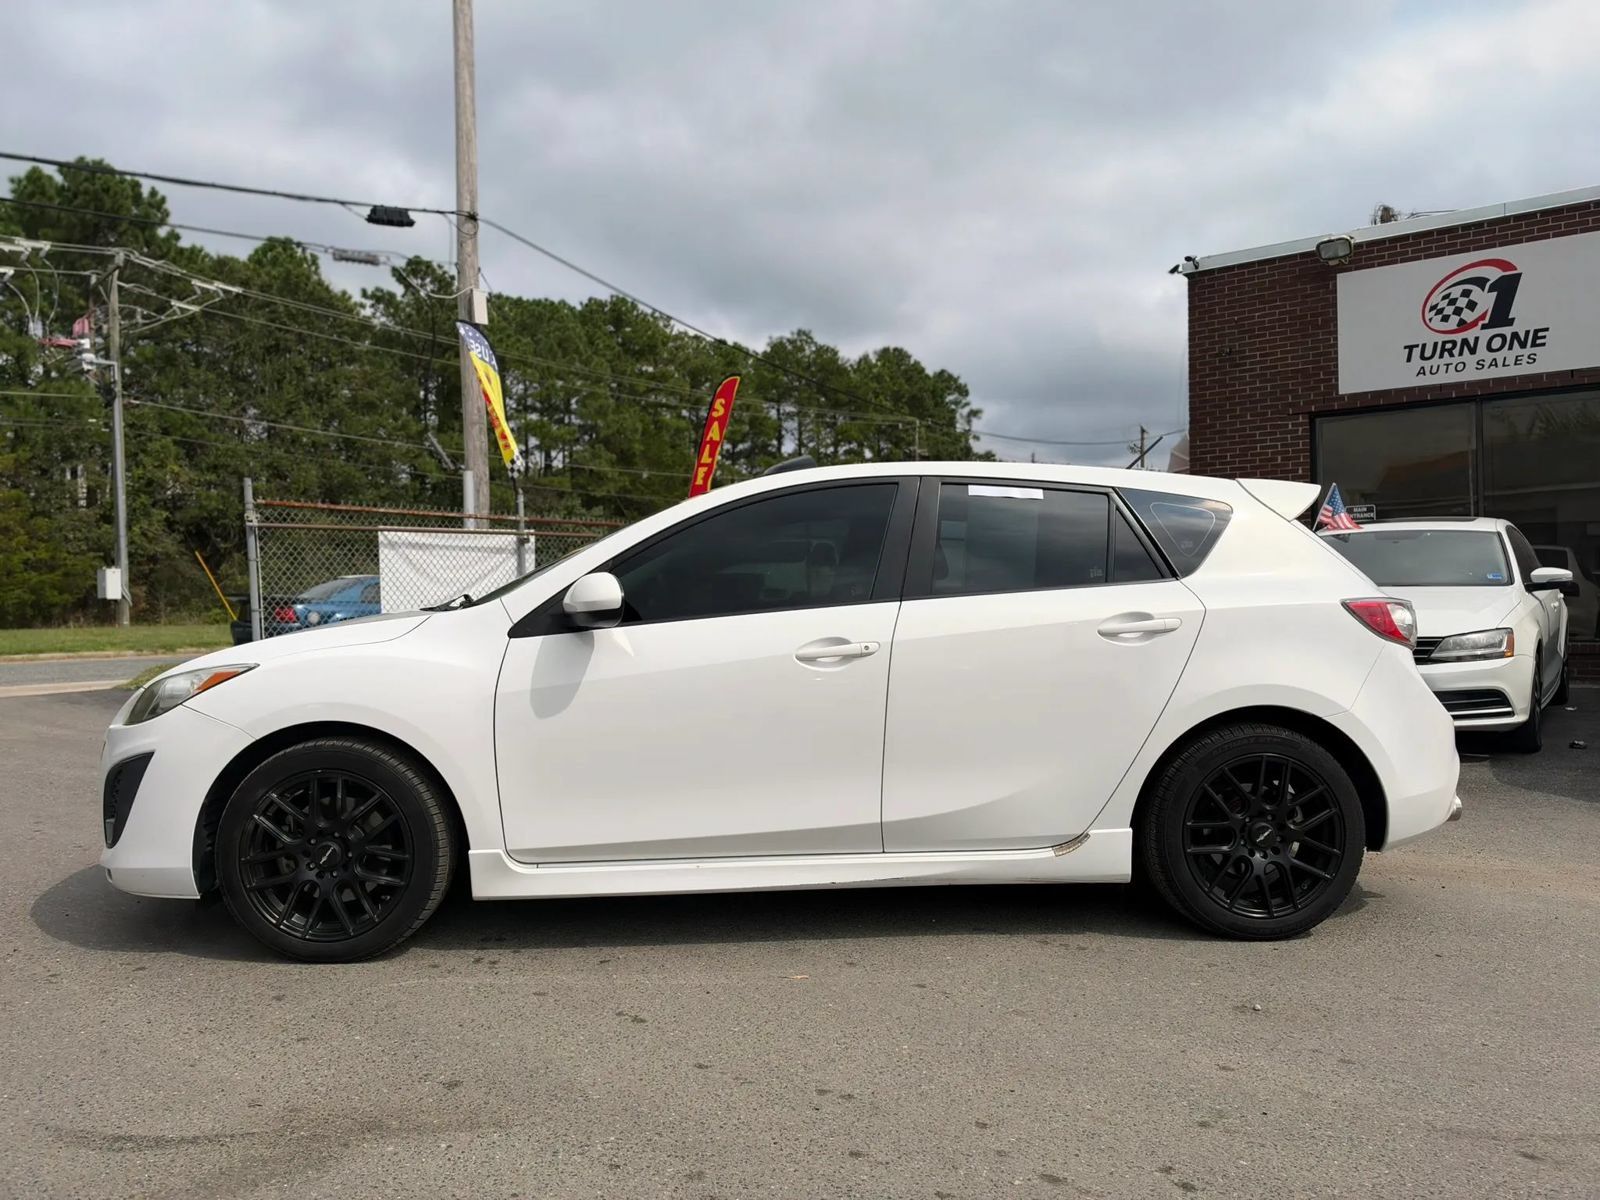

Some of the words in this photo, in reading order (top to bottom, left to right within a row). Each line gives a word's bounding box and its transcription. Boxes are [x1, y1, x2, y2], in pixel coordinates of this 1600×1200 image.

[1403, 336, 1480, 363] TURN
[1486, 327, 1550, 353] ONE
[1416, 361, 1466, 377] AUTO
[1475, 352, 1537, 371] SALES
[695, 398, 725, 485] SALE
